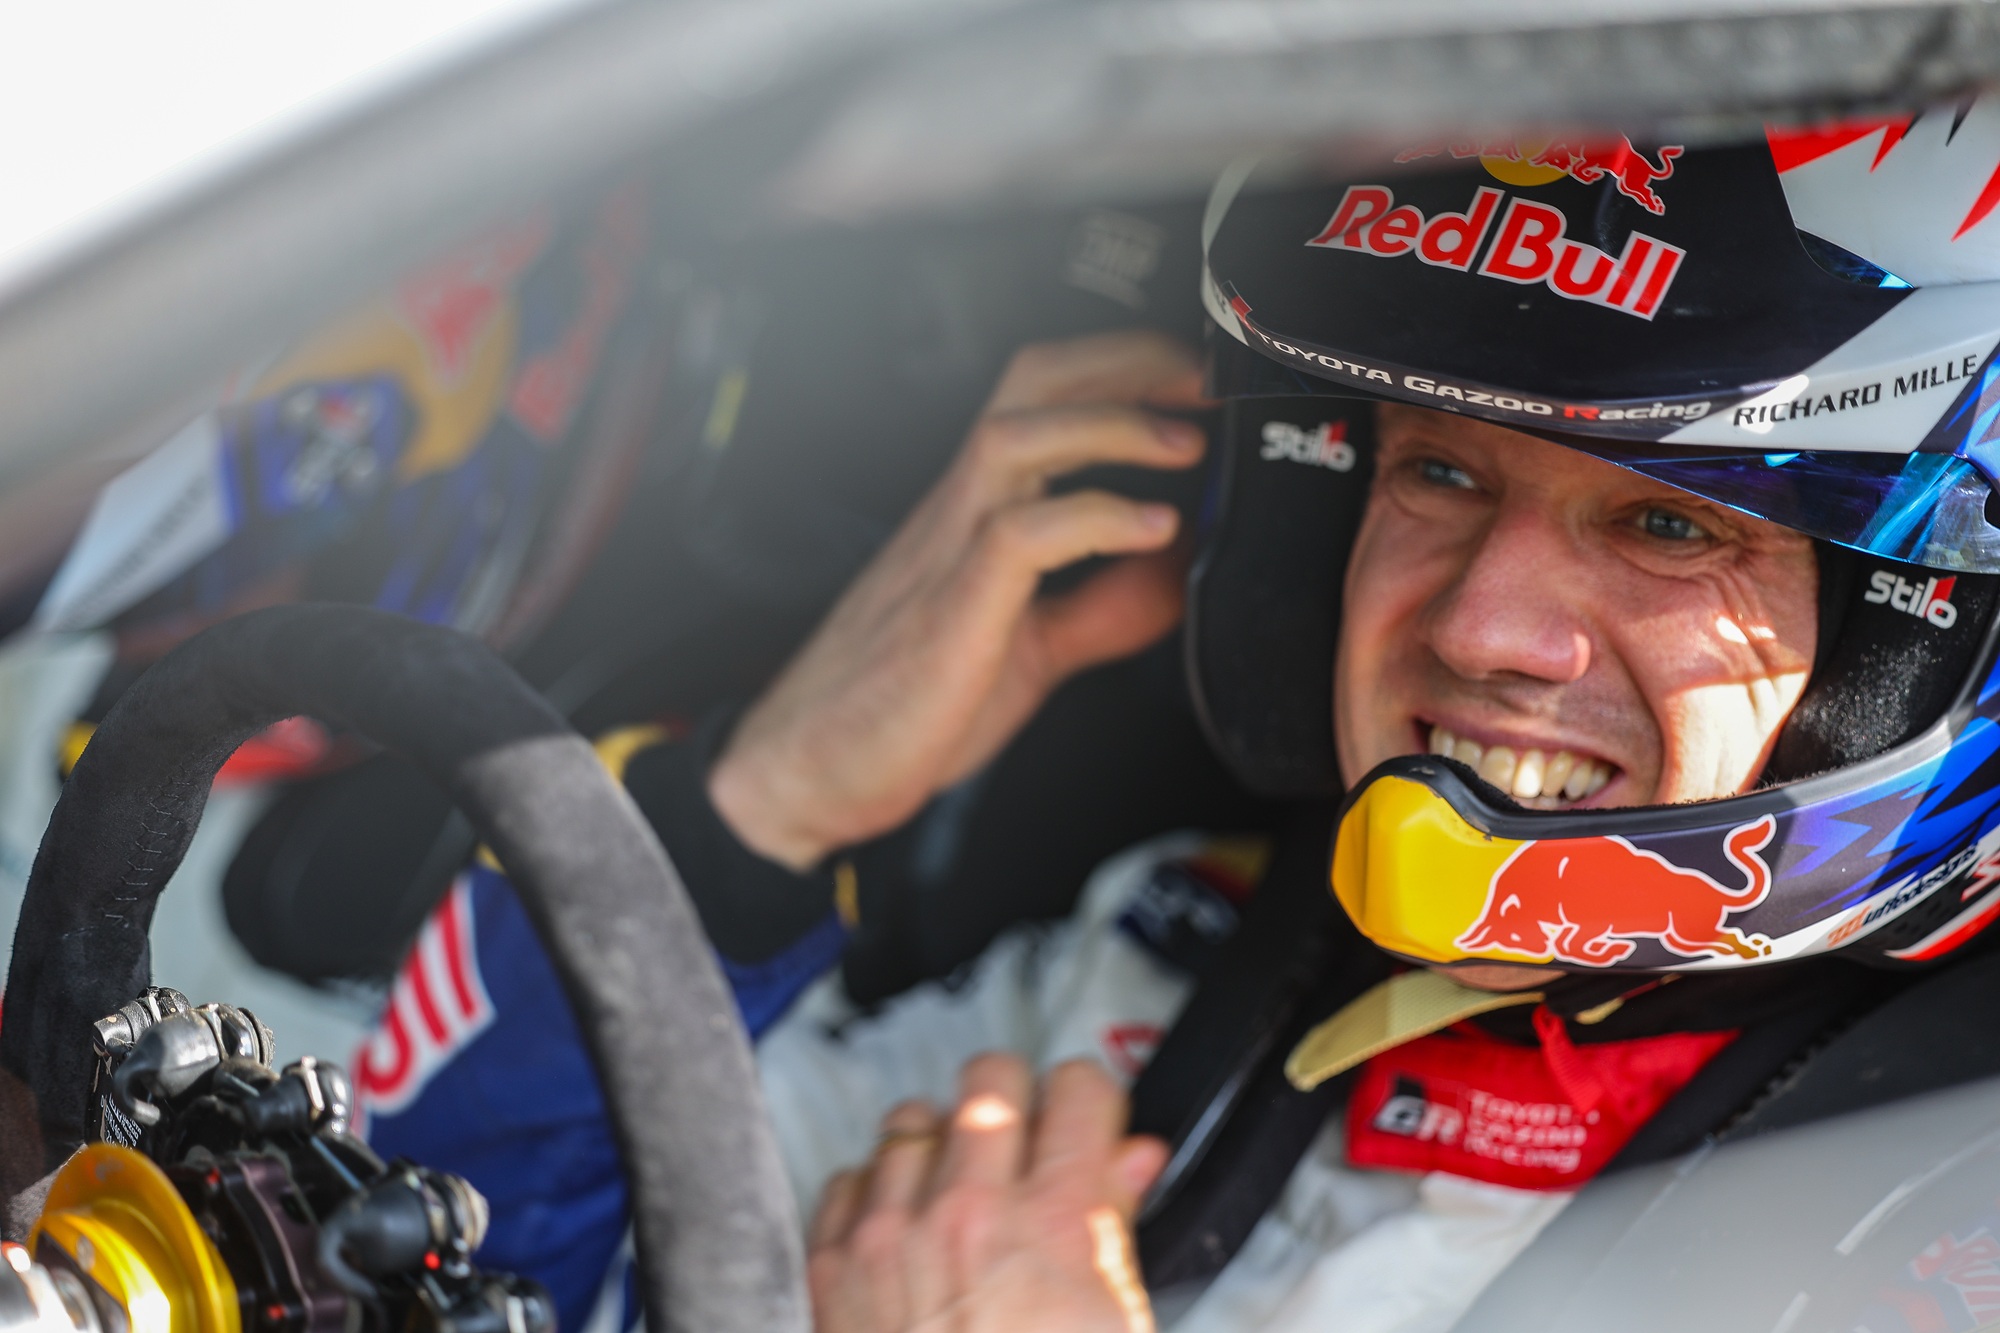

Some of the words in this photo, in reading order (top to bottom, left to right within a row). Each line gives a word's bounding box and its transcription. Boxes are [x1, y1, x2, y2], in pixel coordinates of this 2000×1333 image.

[1310, 187, 1502, 269] Red
[1481, 199, 1684, 318] Bull
[1252, 326, 1393, 385] TOYOTA
[1403, 375, 1553, 415] GAZOO
[1563, 401, 1711, 421] Racing
[1733, 383, 1882, 426] RICHARD
[1894, 354, 1977, 398] MILLE
[1260, 420, 1356, 472] Stilo
[1864, 570, 1957, 629] Stilo
